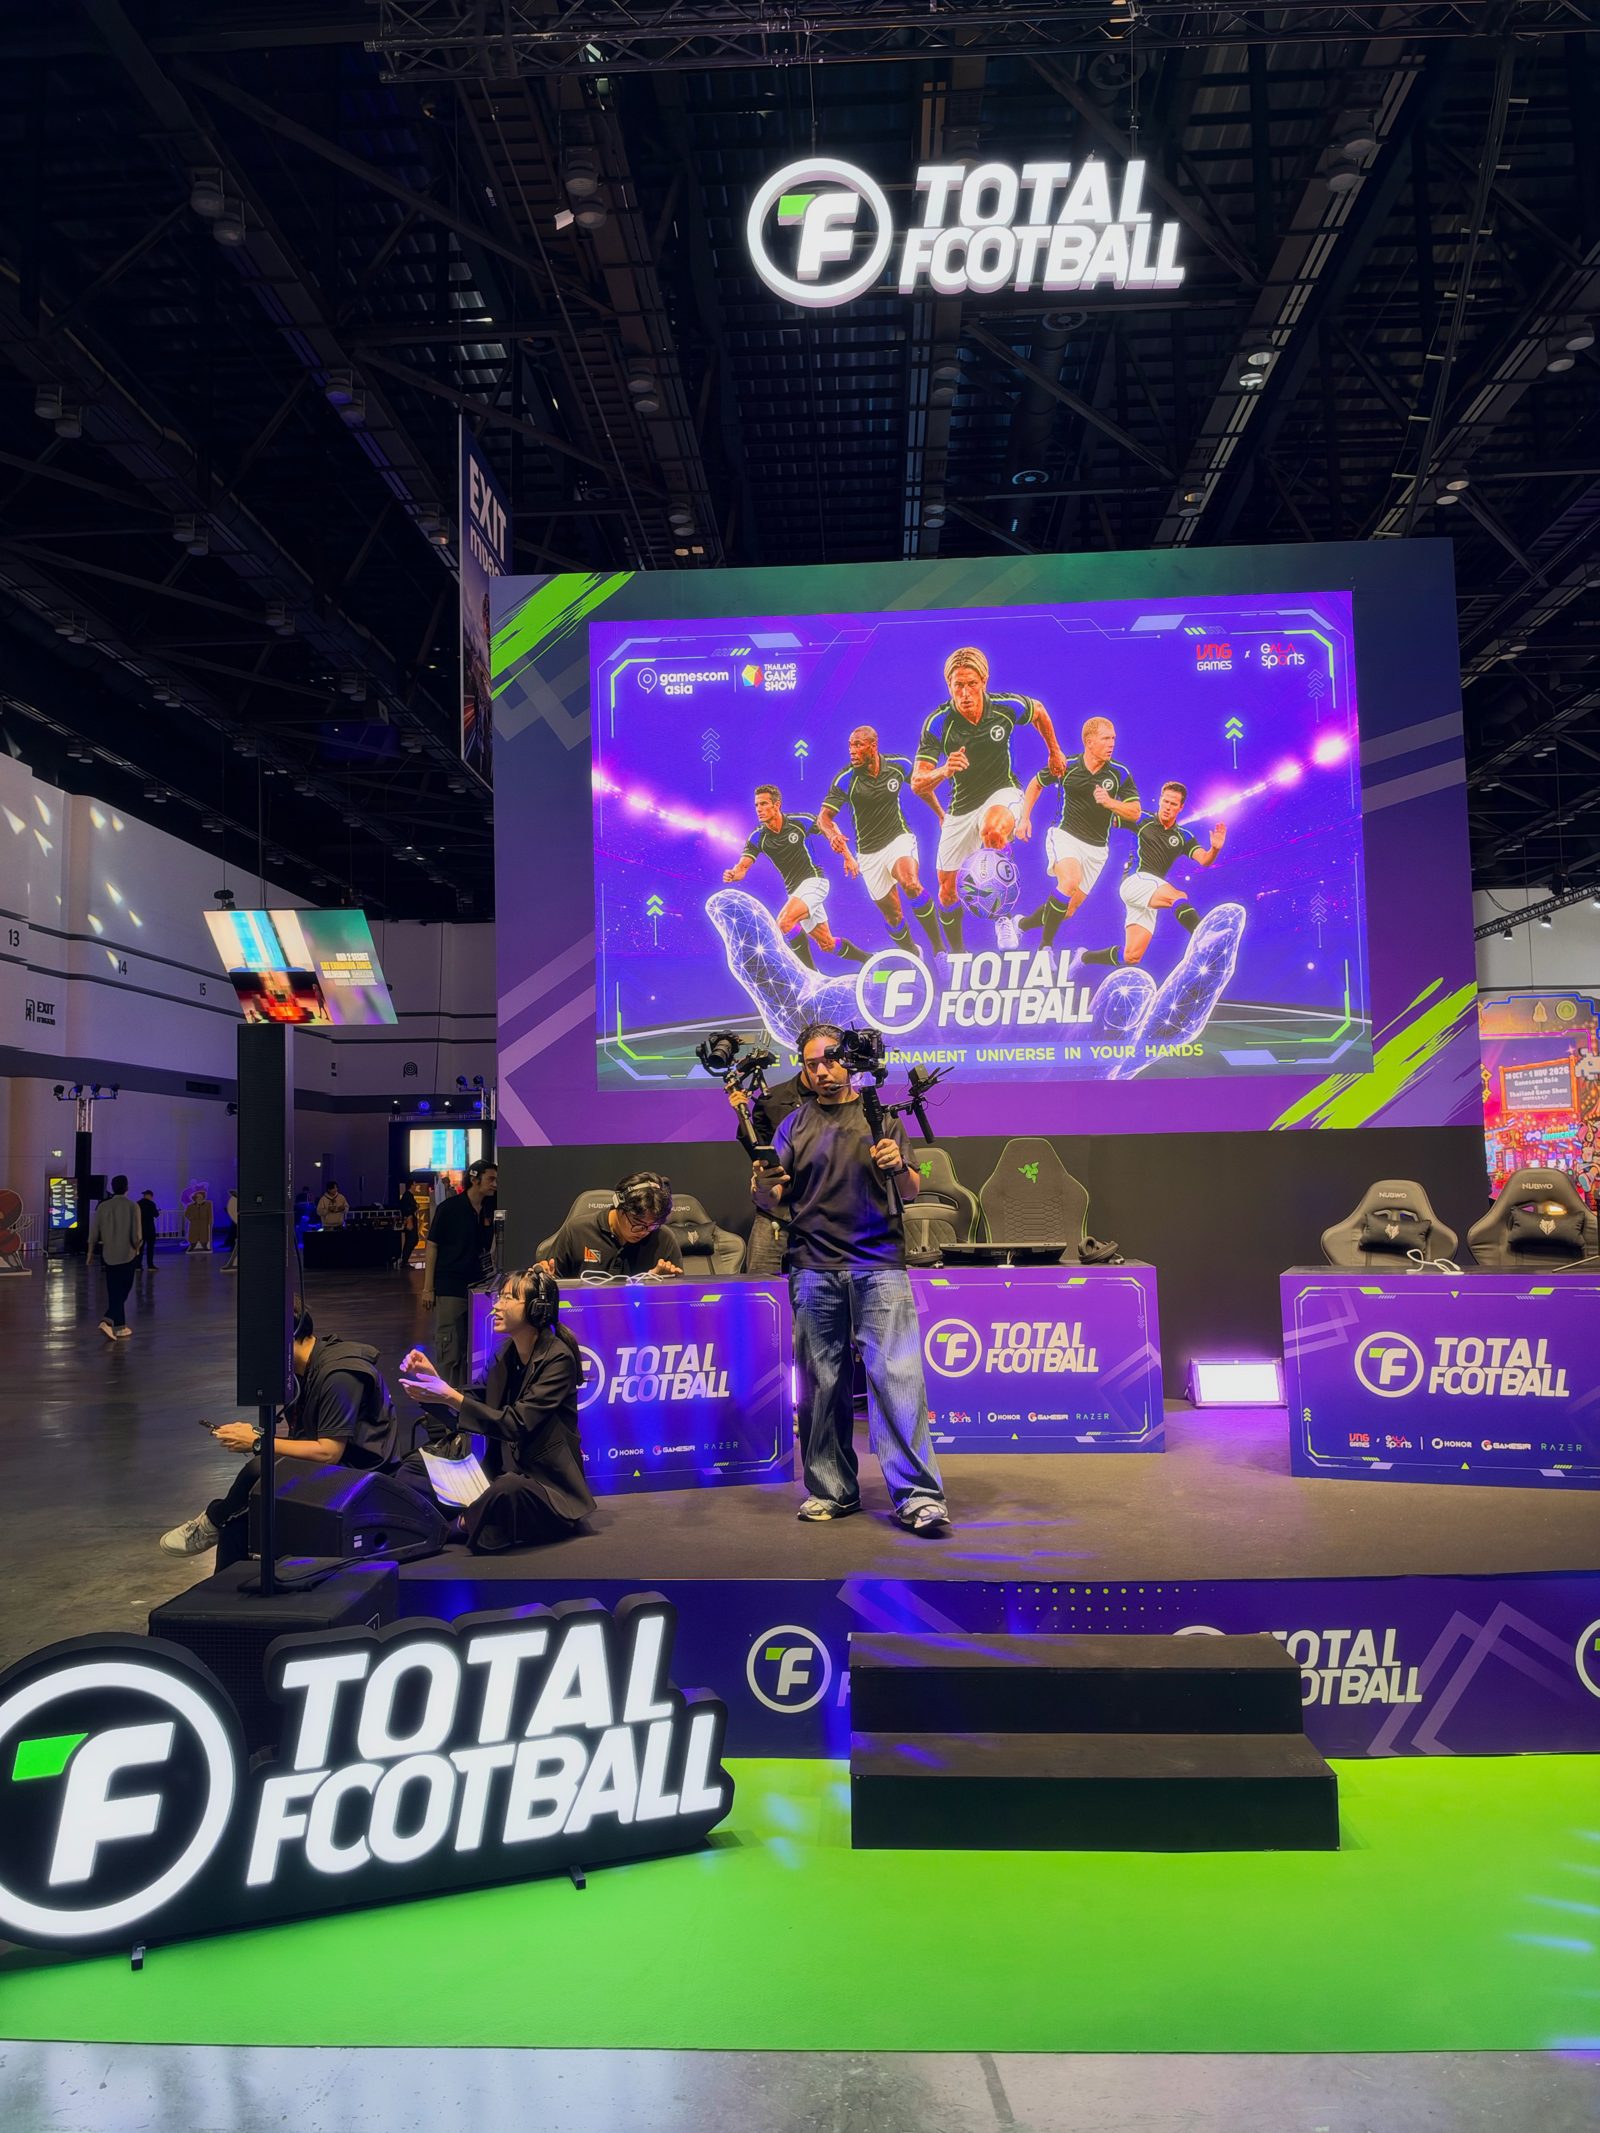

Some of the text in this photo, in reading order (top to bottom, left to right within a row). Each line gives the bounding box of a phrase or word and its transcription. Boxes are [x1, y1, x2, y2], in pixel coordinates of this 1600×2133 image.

[915, 160, 1152, 228] TOTAL
[469, 453, 507, 563] EXIT
[1197, 660, 1232, 671] GAMES
[659, 670, 729, 686] gamescom
[764, 670, 797, 681] GAME
[664, 683, 693, 695] asia
[764, 681, 797, 691] SHOW
[8, 928, 20, 947] 13
[118, 960, 128, 975] 14
[946, 950, 1076, 989] TOTAL
[199, 982, 206, 996] 15
[37, 1001, 55, 1015] EXIT
[879, 1044, 1204, 1064] URNAMENT UNIVERSE IN YOUR HANDS
[1522, 1182, 1553, 1190] NUBWO
[990, 1321, 1086, 1349] TOTAL
[615, 1343, 718, 1377] TOTAL
[1433, 1337, 1552, 1368] TOTAL
[997, 1413, 1021, 1421] HONOR
[619, 1448, 644, 1456] HONOR
[703, 1441, 739, 1450] RAZER
[1541, 1443, 1583, 1451] RAZER
[281, 1615, 673, 1771] TOTAL
[1301, 1667, 1423, 1706] OTBALL
